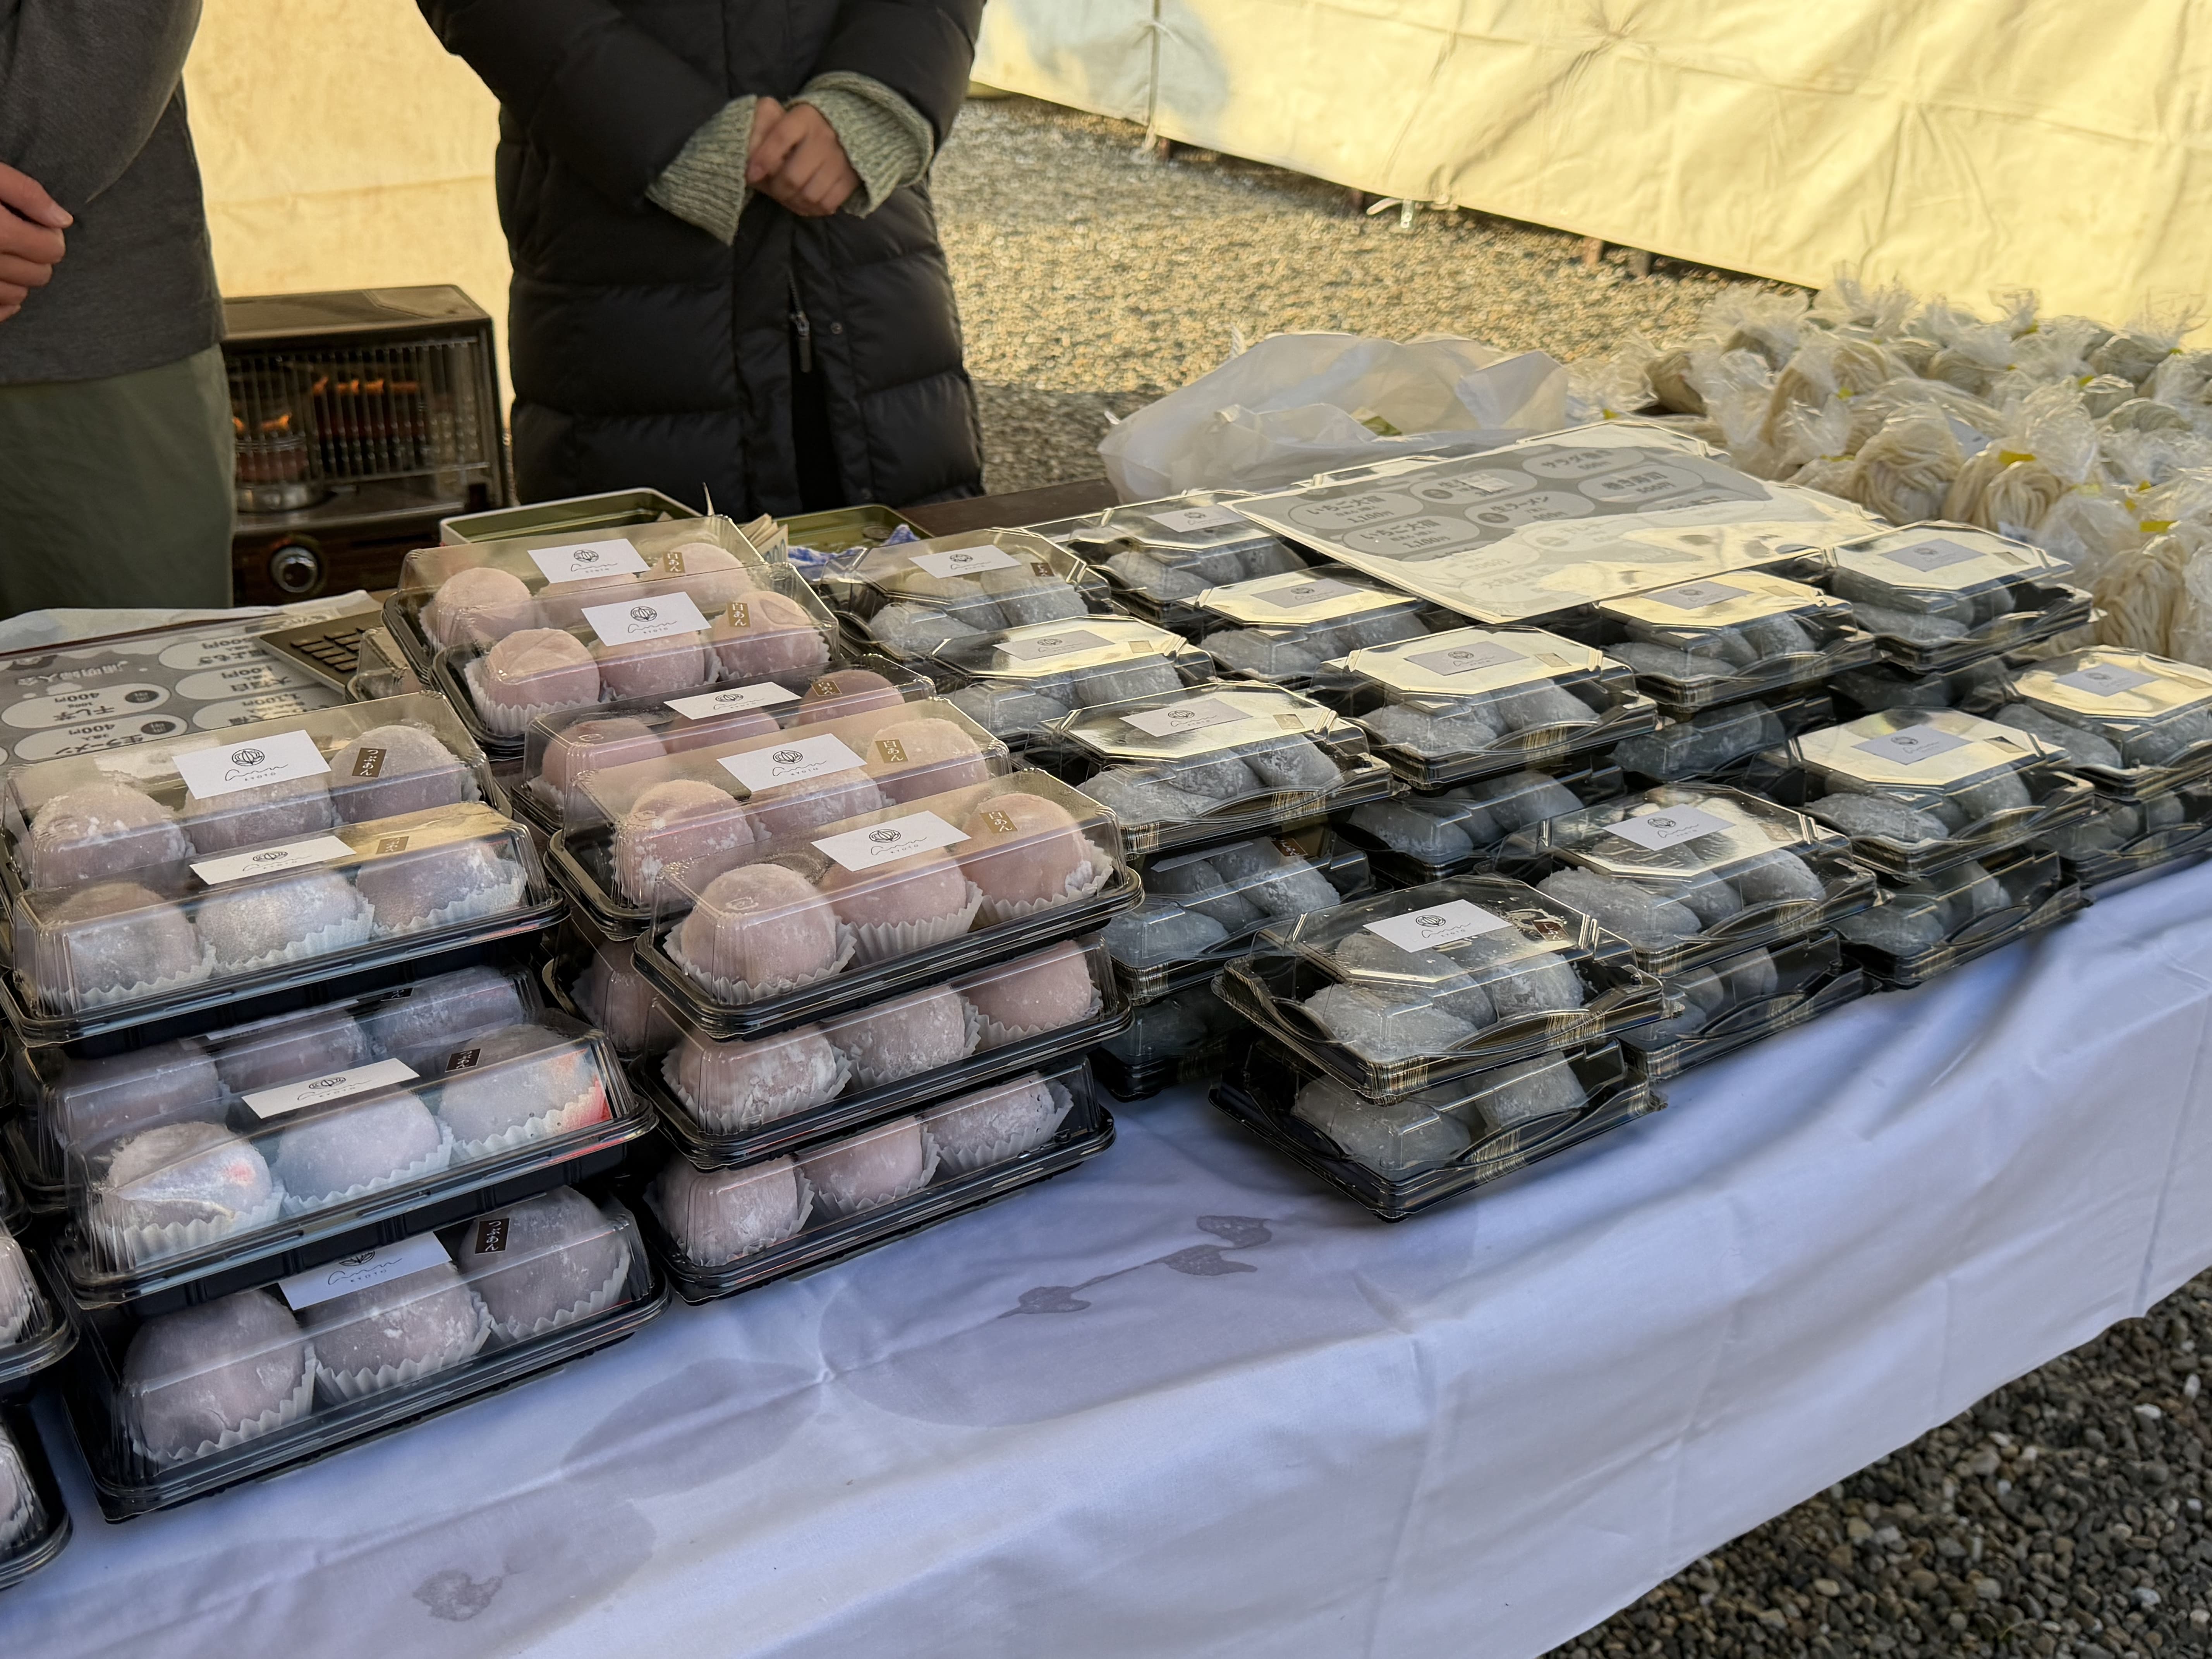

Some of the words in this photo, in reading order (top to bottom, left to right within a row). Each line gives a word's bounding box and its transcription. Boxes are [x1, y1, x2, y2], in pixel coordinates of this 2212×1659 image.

[1347, 511, 1395, 523] 1,100円
[1402, 536, 1451, 548] 1,100円
[667, 553, 682, 572] 白あん
[732, 603, 747, 626] 白あん
[54, 692, 100, 703] 400円
[69, 724, 116, 735] 400円
[55, 734, 143, 755] 生ラーメン
[883, 740, 904, 761] 白あん
[361, 748, 380, 776] つぶあん
[988, 811, 1012, 832] 白あん
[484, 1220, 501, 1252] つぶあん
